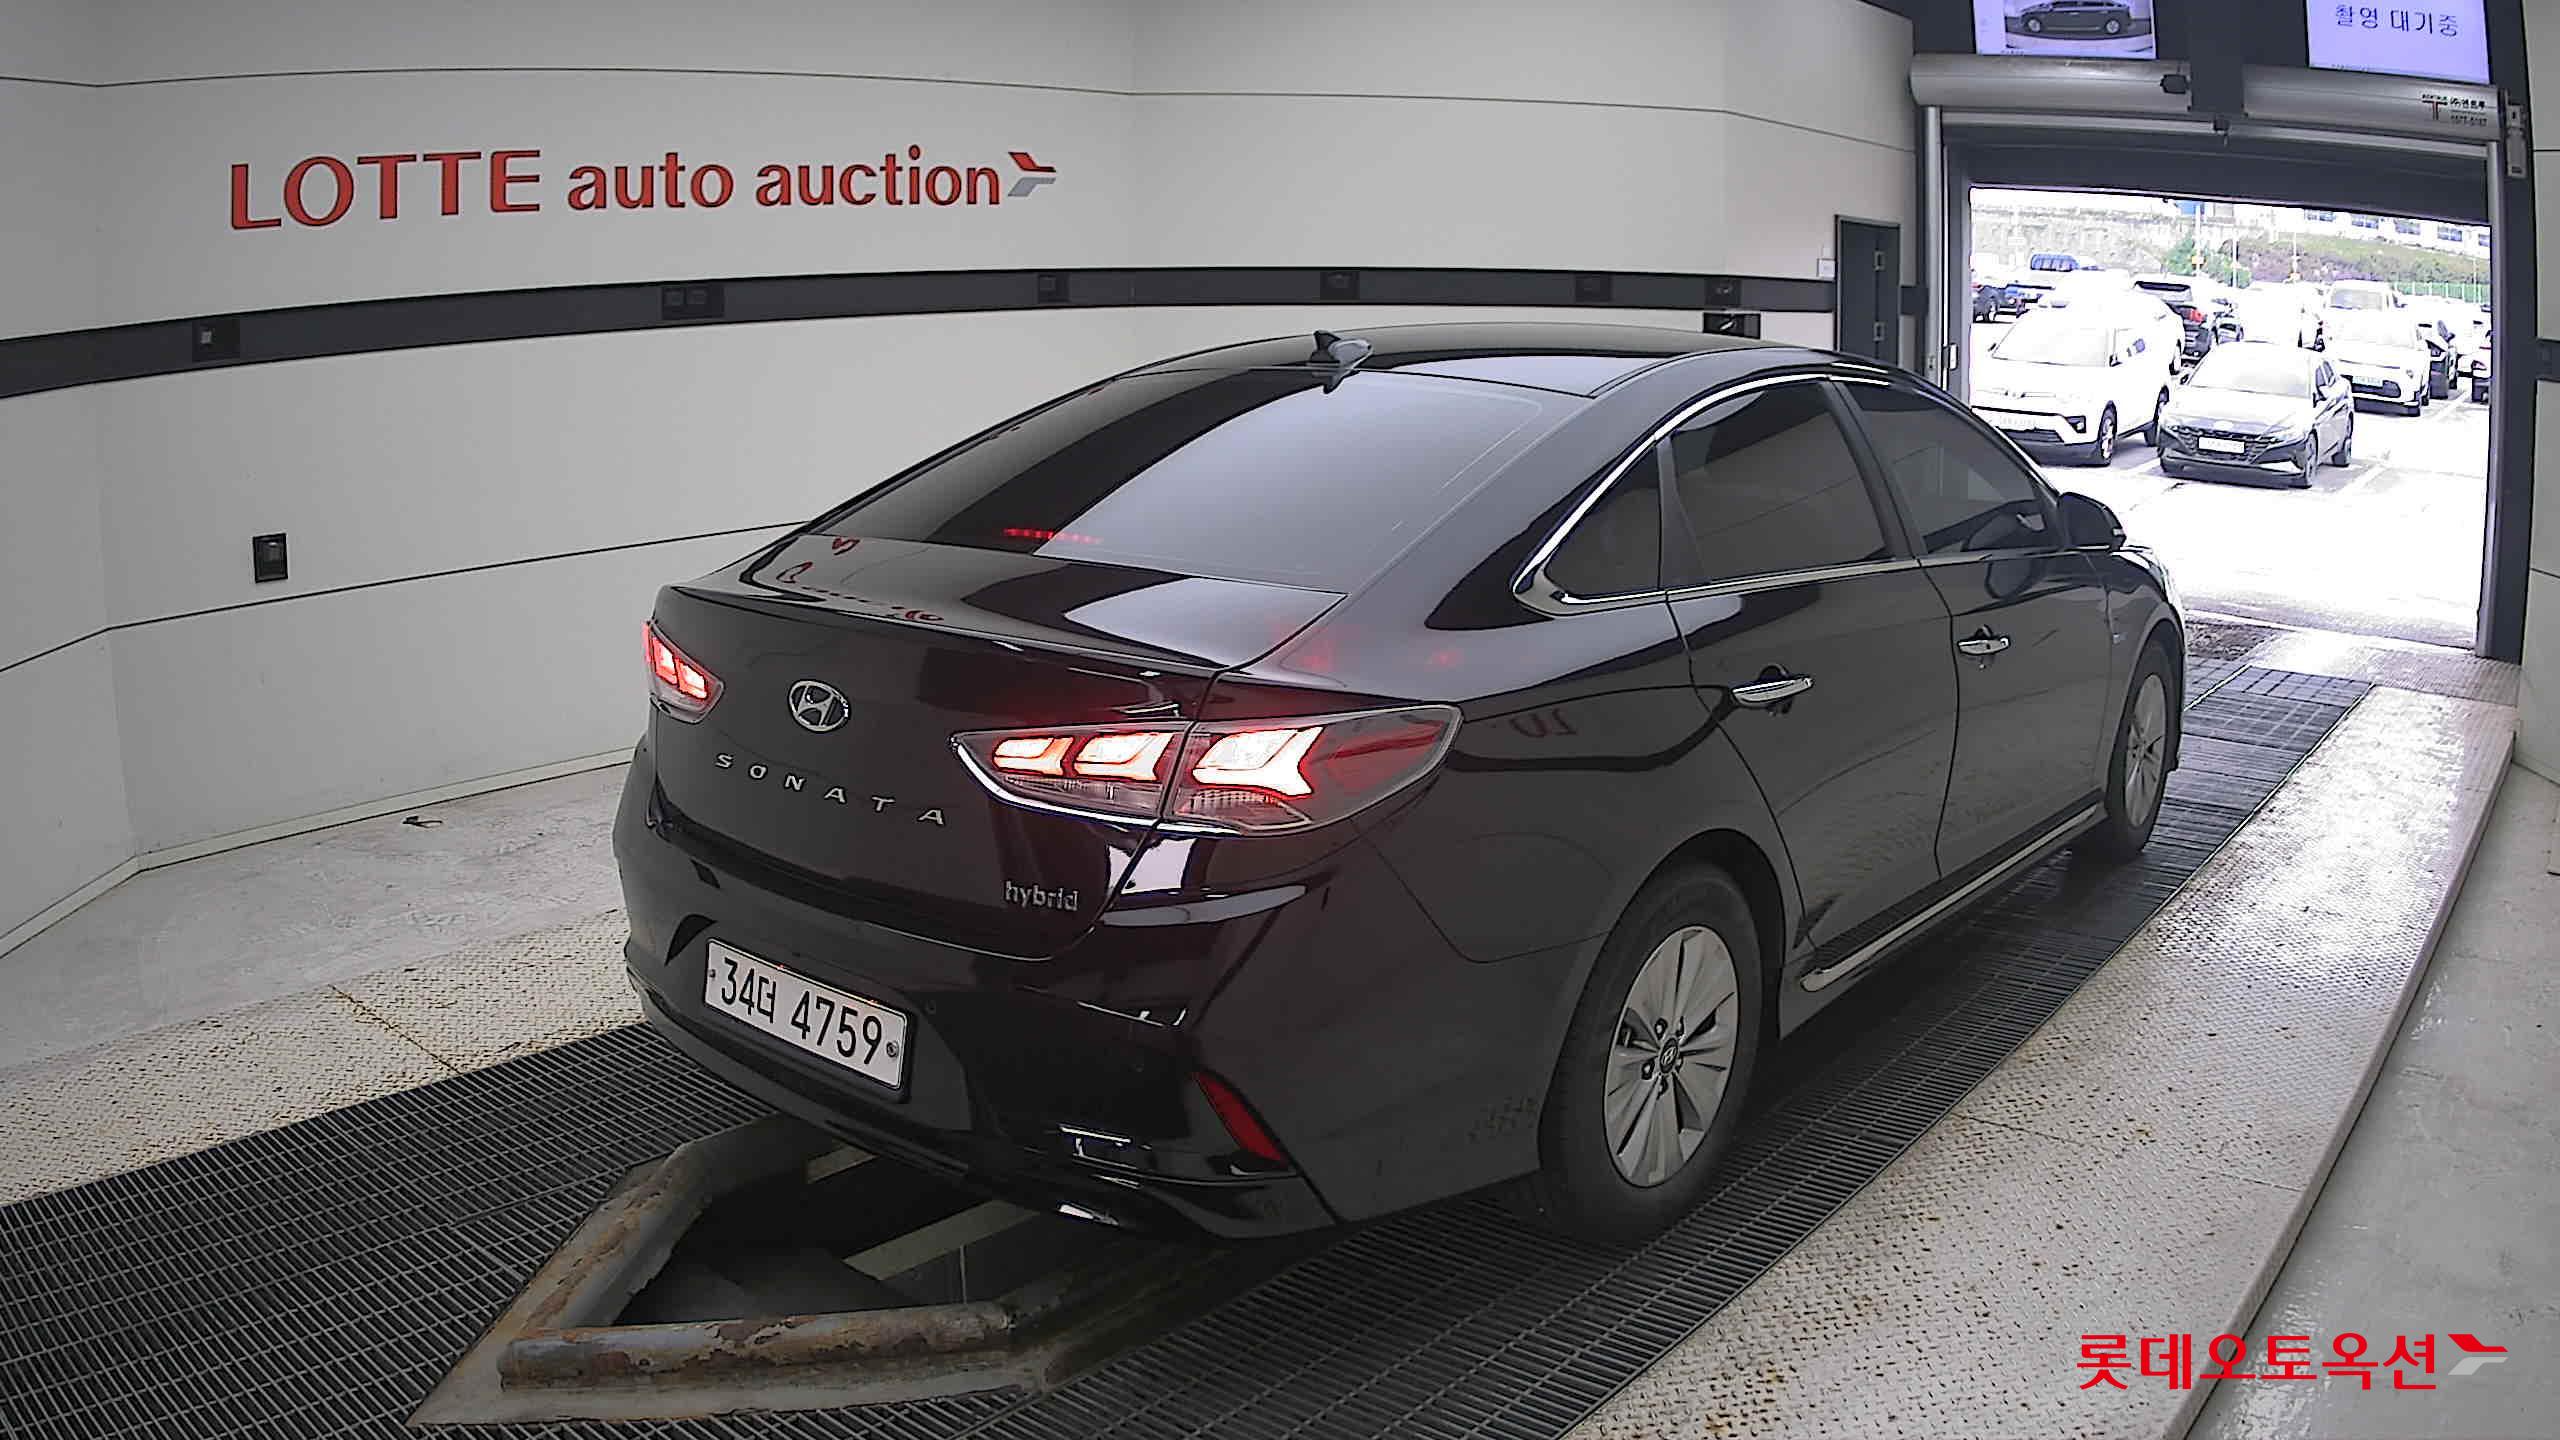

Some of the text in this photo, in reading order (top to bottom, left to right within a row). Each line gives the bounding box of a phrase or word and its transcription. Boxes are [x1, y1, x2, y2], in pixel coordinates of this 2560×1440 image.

[2335, 4, 2458, 38] 촬영 대기중
[231, 145, 1002, 229] LOTTE auto auction
[715, 753, 945, 825] SONATA
[1005, 880, 1078, 911] hybrid
[721, 956, 883, 1065] 34더 4759
